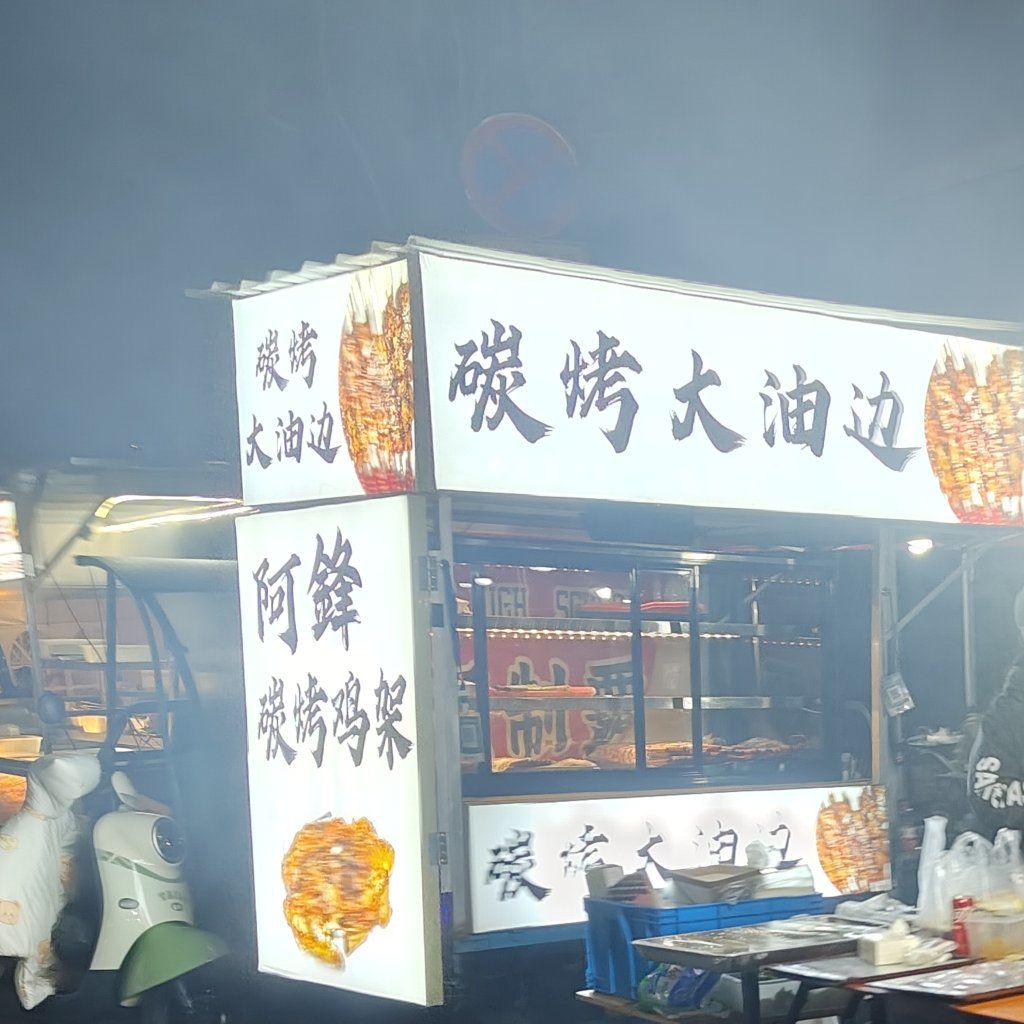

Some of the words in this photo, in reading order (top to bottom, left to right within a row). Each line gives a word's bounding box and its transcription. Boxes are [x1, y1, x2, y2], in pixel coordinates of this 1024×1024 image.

[255, 321, 319, 392] 碳烤
[447, 319, 922, 473] 碳烤大油边
[246, 400, 342, 470] 大油边
[257, 667, 415, 772] 碳烤鸡架
